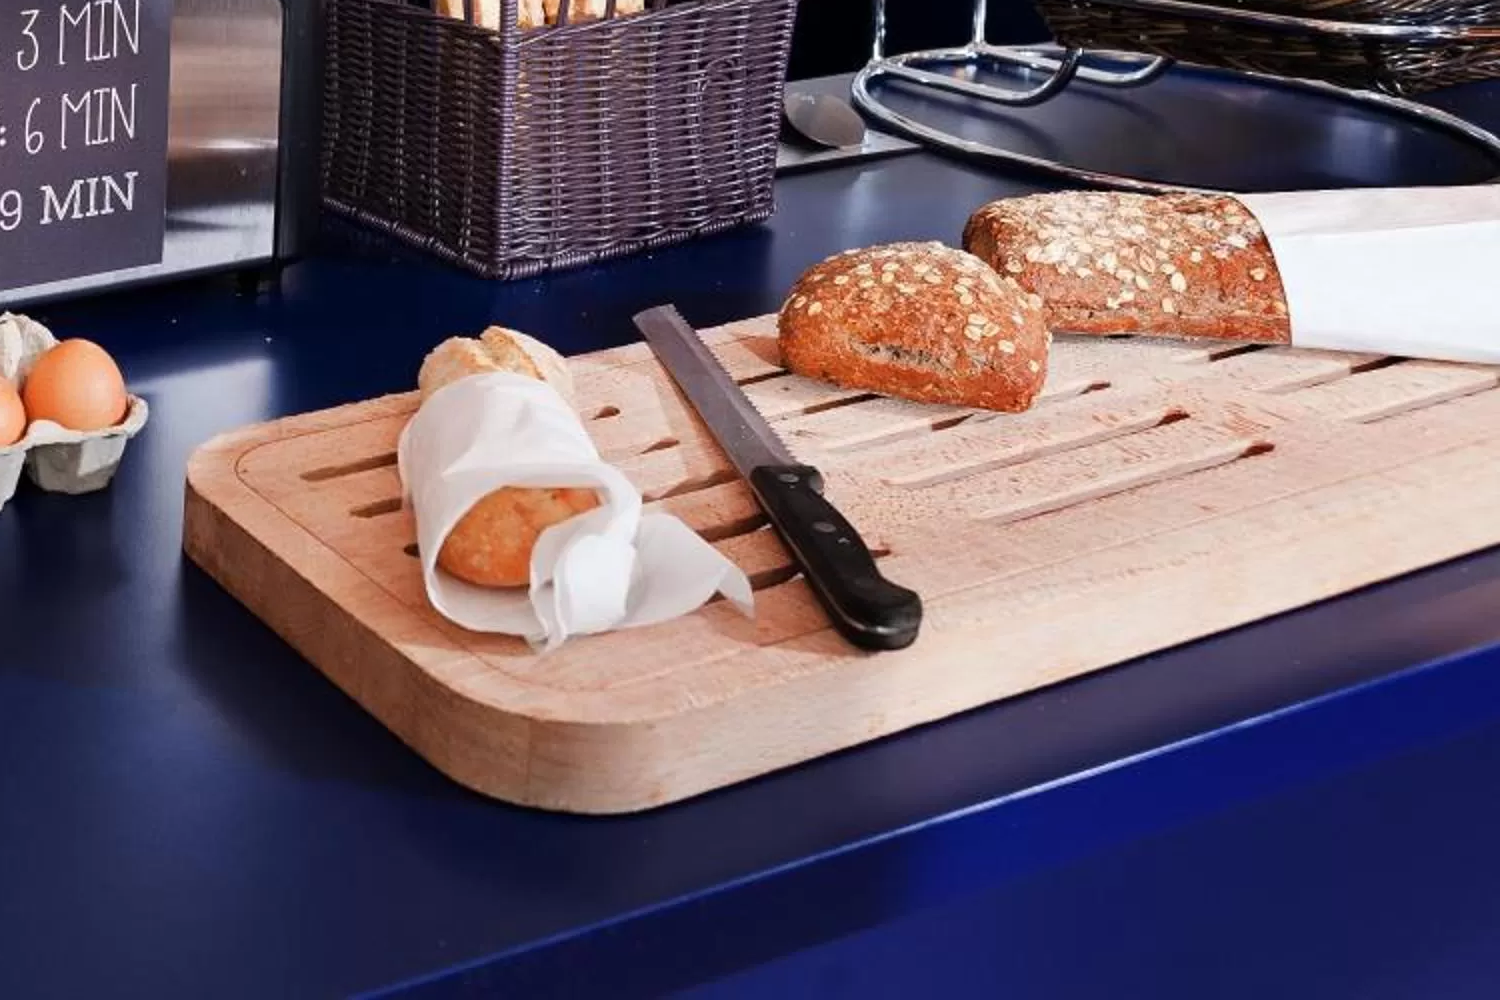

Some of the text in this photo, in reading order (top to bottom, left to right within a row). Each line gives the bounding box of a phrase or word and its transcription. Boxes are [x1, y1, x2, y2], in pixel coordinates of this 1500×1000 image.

[16, 8, 41, 71] 3
[24, 97, 44, 155] 6
[59, 83, 139, 151] MIN
[39, 171, 140, 226] MIN
